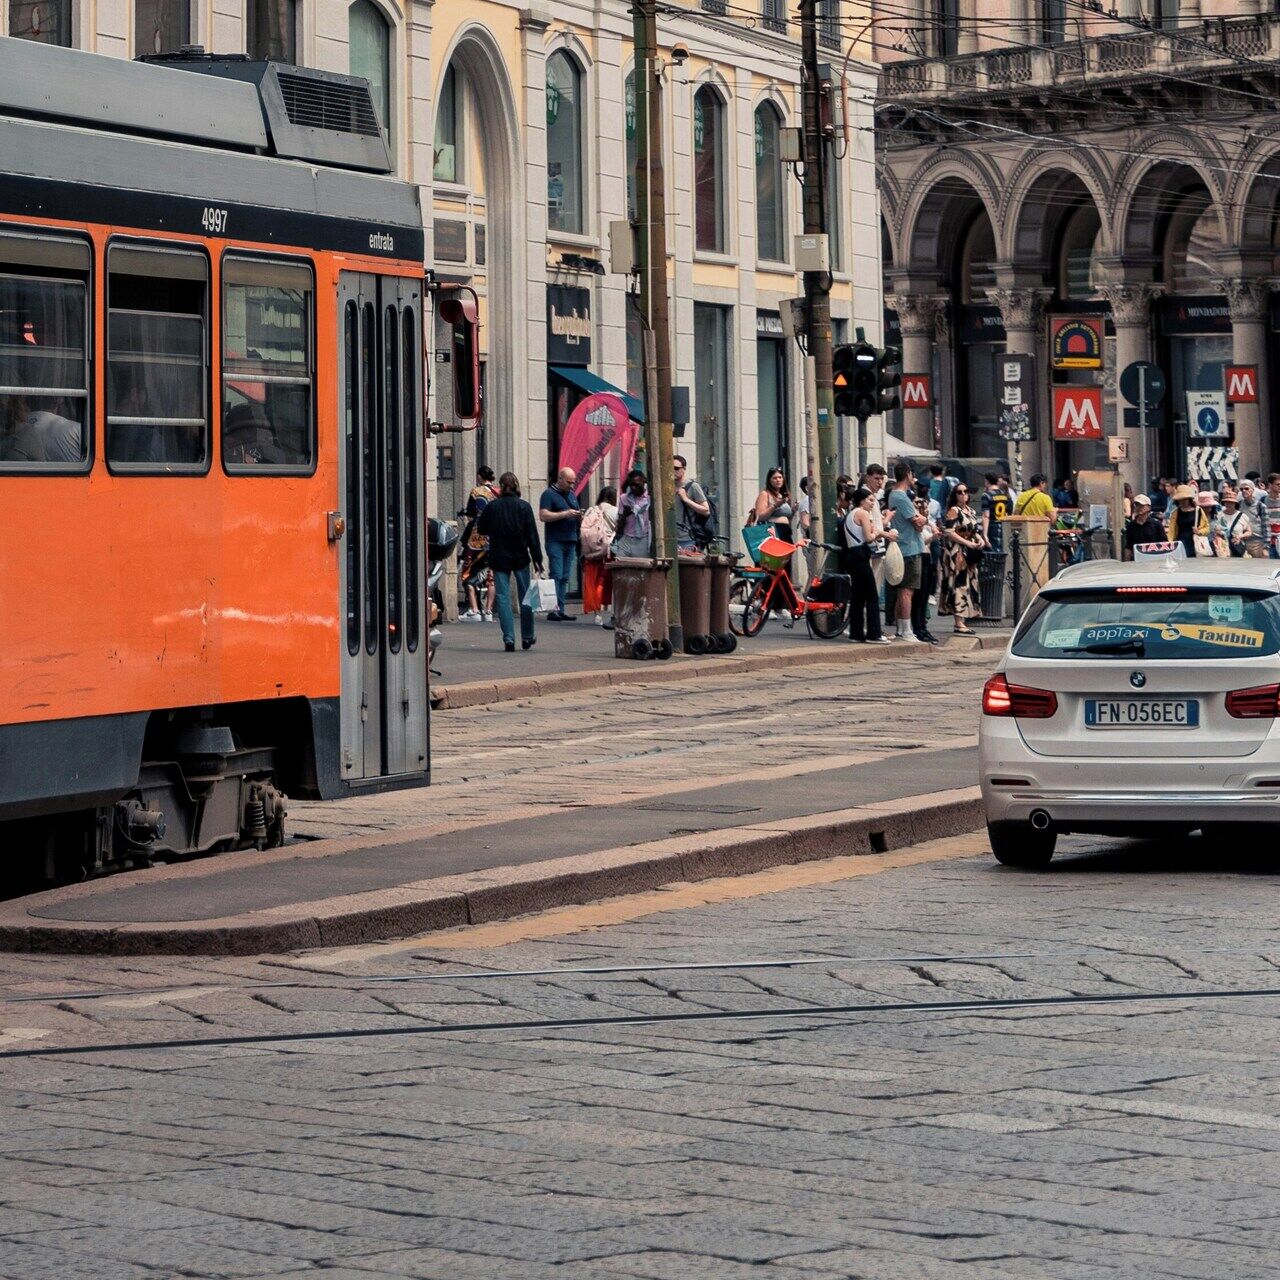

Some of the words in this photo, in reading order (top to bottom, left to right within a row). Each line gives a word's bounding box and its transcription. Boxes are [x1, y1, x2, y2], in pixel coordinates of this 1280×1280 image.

[201, 207, 228, 233] 4997
[369, 231, 394, 251] entrata
[903, 381, 928, 402] M
[1228, 373, 1255, 396] M
[1057, 398, 1101, 430] M
[995, 502, 1006, 521] 9
[1140, 542, 1176, 552] TAXI
[1086, 626, 1150, 640] appTaxi
[1198, 628, 1257, 647] Taxiblu
[1098, 704, 1120, 723] FN
[1127, 703, 1186, 723] 056EC
